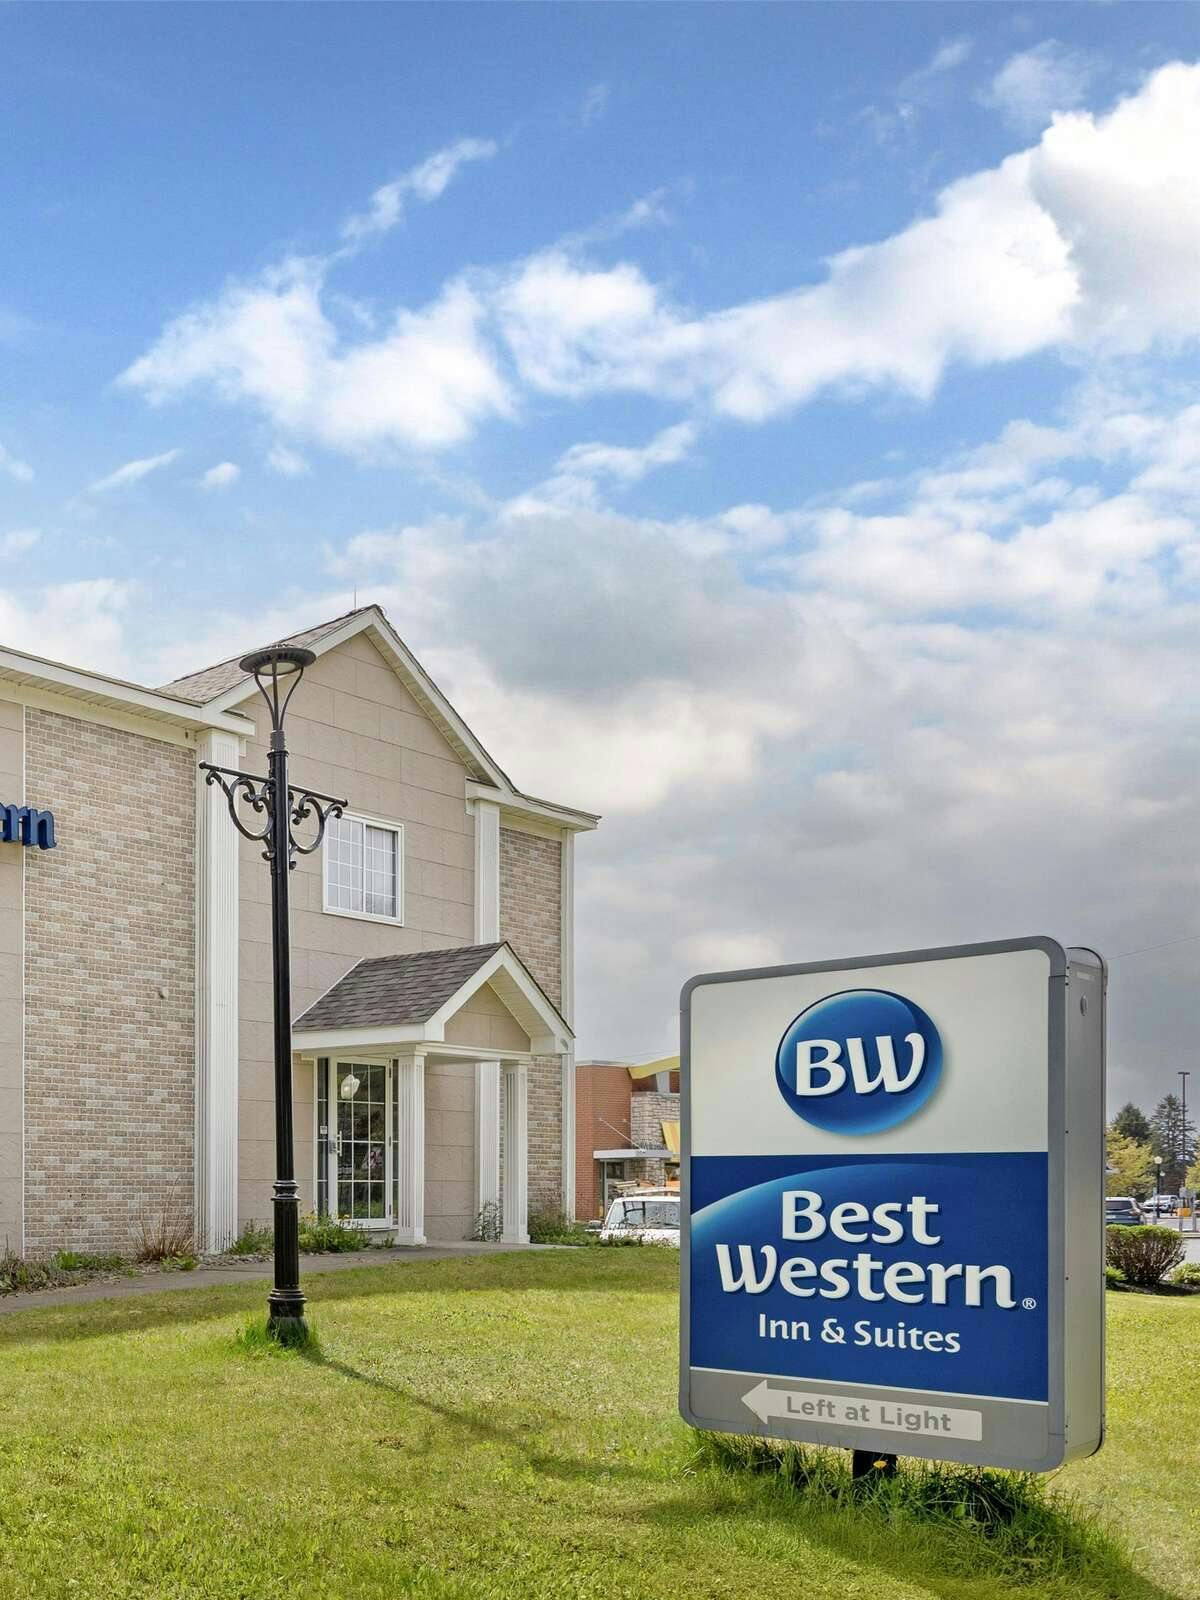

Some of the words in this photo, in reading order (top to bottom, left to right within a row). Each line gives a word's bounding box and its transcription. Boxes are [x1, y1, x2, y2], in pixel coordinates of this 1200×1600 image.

[795, 1032, 926, 1097] BW
[781, 1190, 941, 1245] Best
[758, 1313, 811, 1341] Inn
[820, 1317, 847, 1345] &
[854, 1319, 961, 1353] Suites
[786, 1396, 836, 1419] Left
[844, 1403, 870, 1423] at
[880, 1408, 951, 1432] Light
